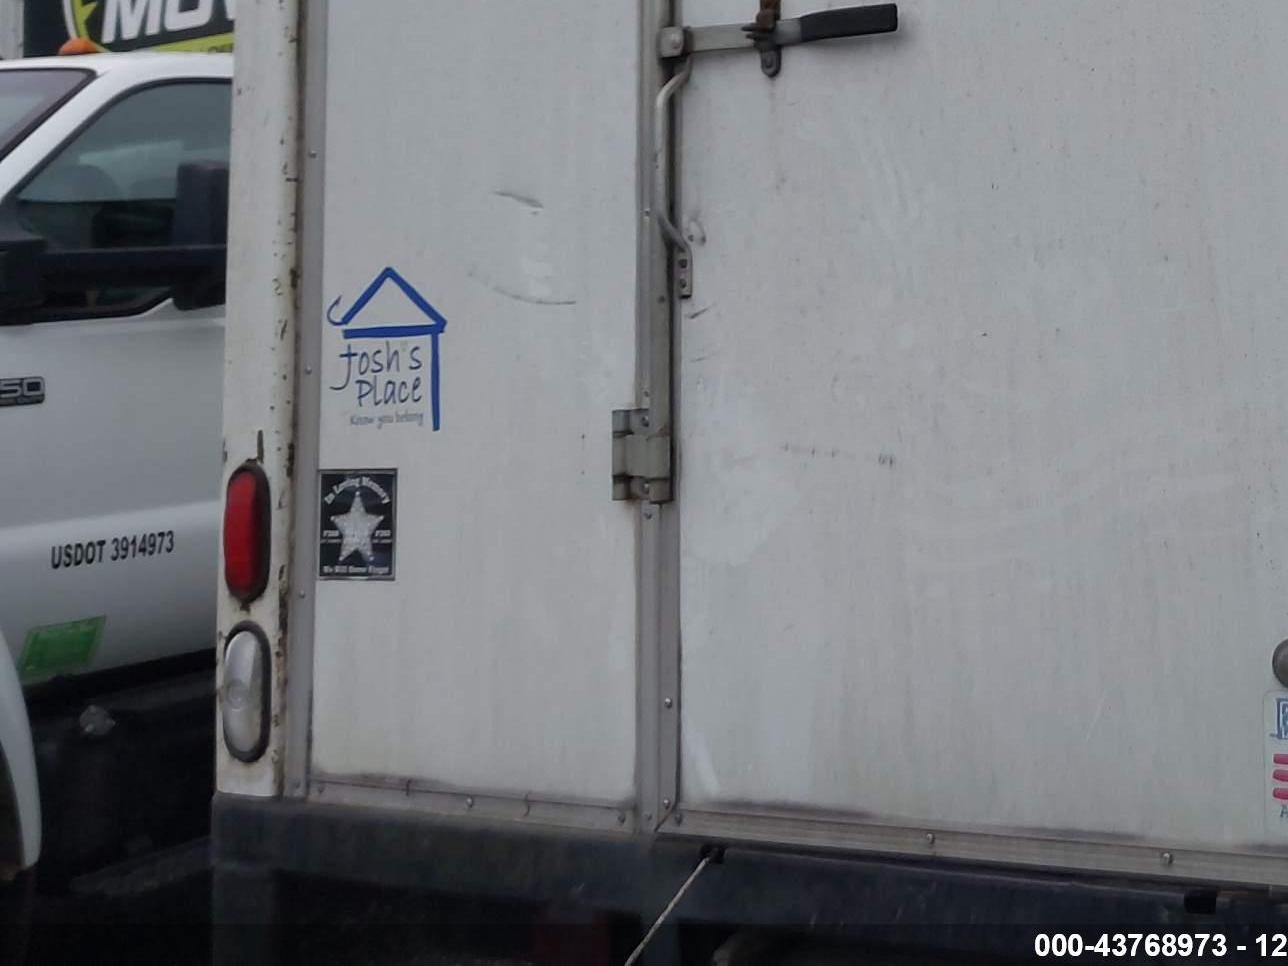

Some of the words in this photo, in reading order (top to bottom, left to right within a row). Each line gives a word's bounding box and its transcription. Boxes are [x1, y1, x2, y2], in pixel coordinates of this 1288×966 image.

[329, 340, 423, 392] Josh's
[354, 376, 423, 408] Place
[51, 539, 106, 569] USDOT
[111, 531, 175, 561] 3914973
